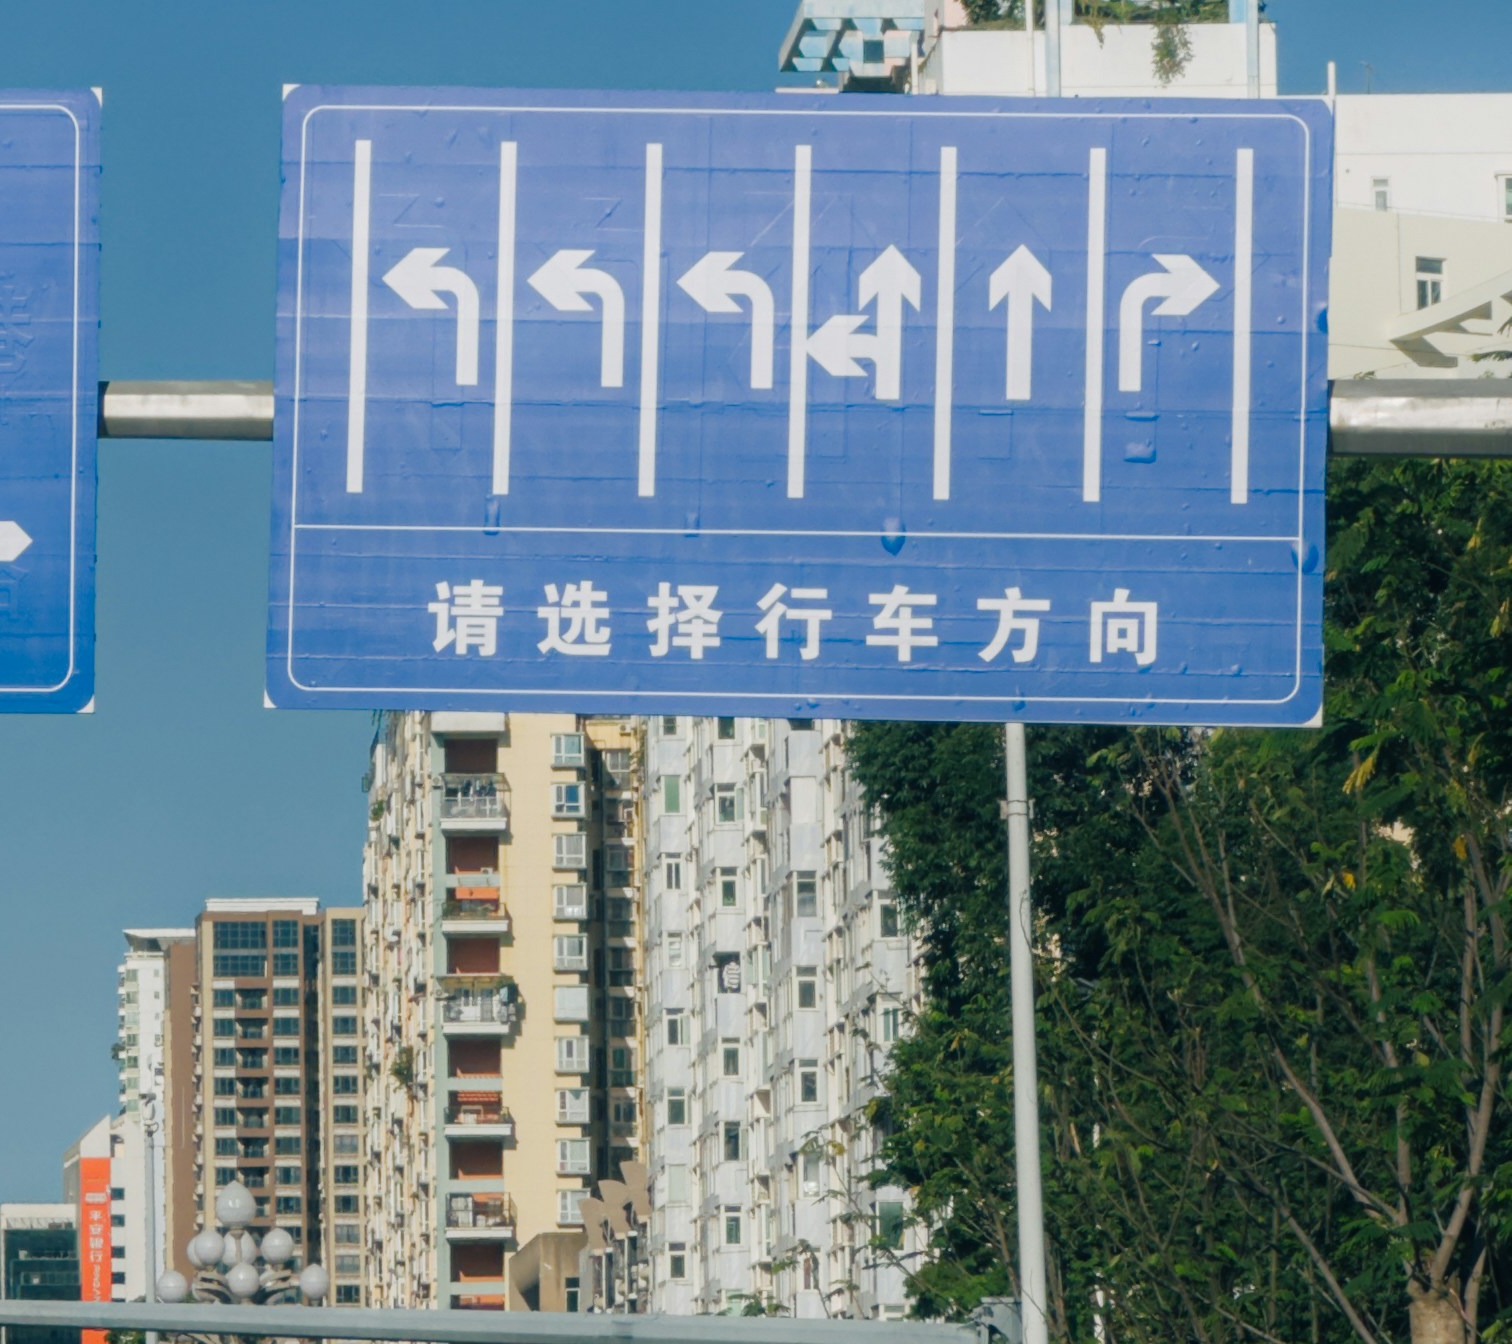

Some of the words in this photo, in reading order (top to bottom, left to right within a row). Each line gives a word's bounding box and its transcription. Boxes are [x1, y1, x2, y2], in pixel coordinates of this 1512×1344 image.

[428, 580, 1158, 665] 请选择行车方向
